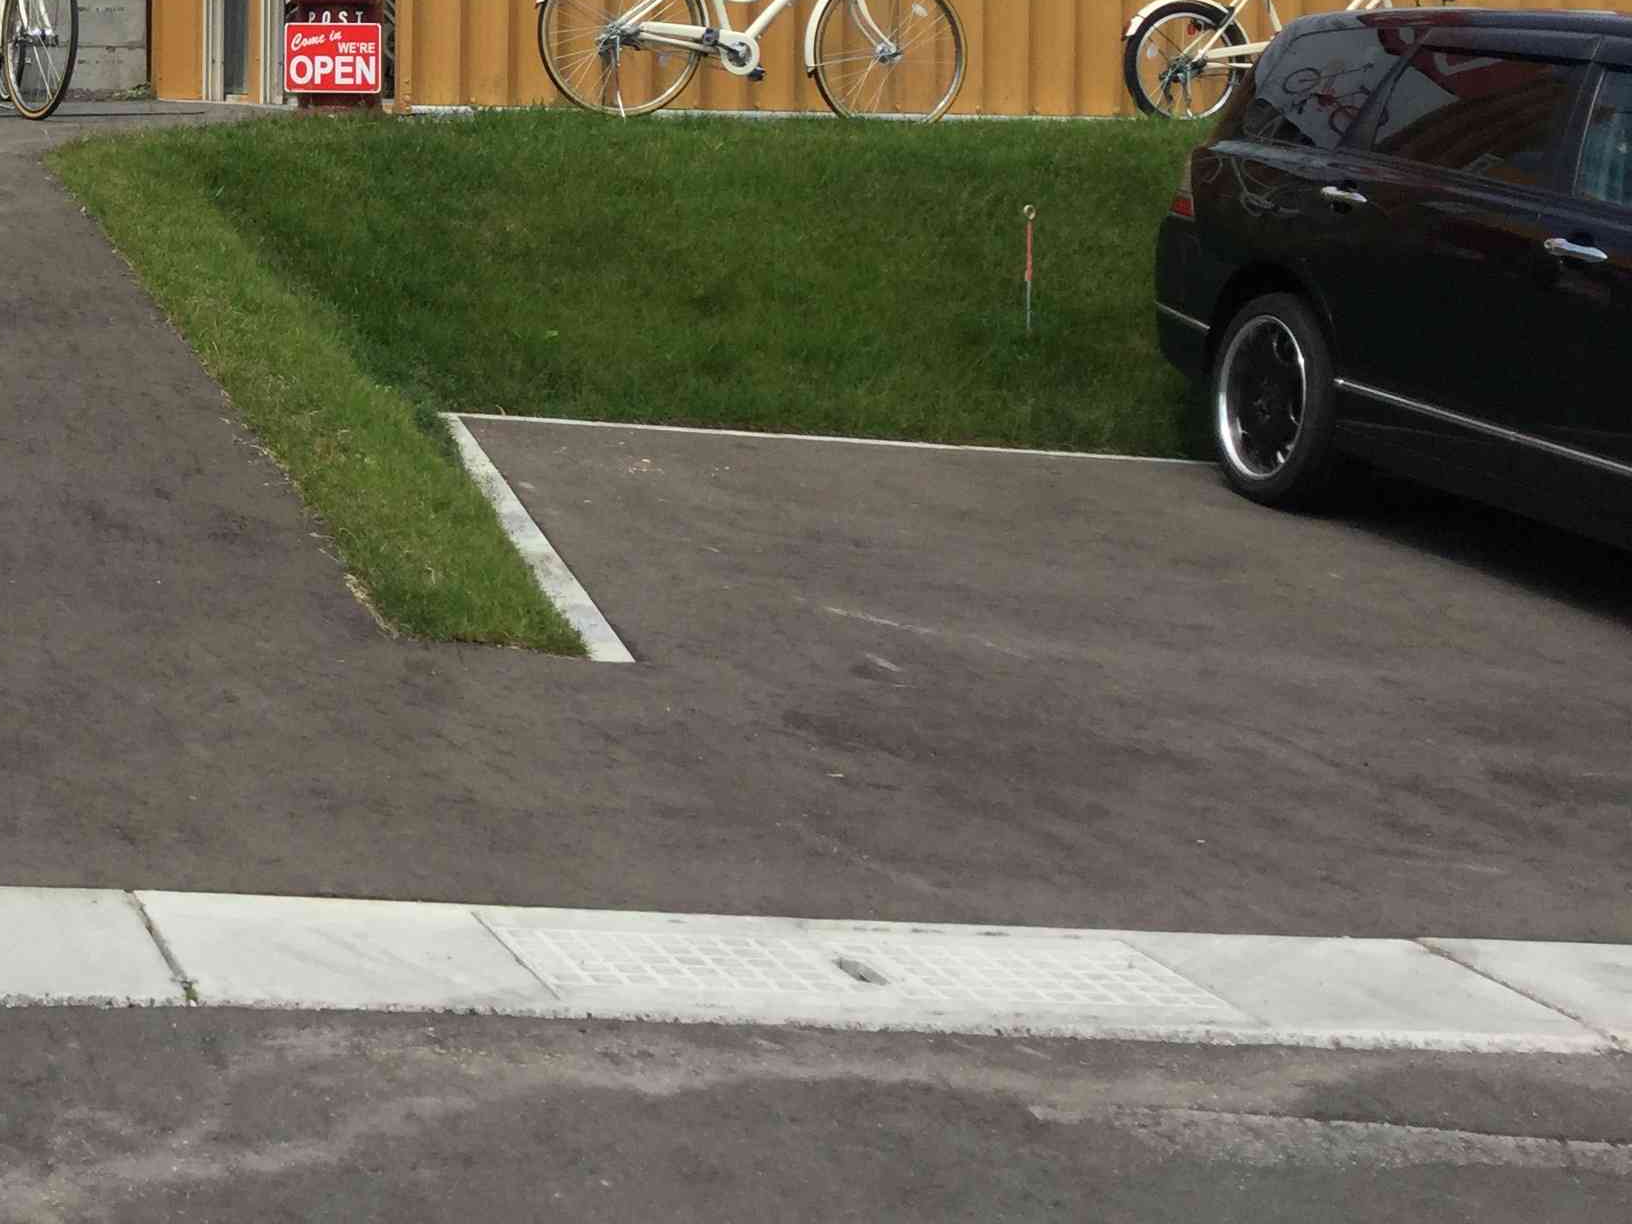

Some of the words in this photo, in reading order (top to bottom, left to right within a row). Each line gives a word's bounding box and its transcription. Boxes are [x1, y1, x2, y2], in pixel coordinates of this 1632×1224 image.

[308, 10, 364, 24] POST
[291, 33, 326, 52] Come
[329, 30, 343, 42] in
[338, 42, 377, 54] WE'RE
[289, 55, 377, 85] OPEN
